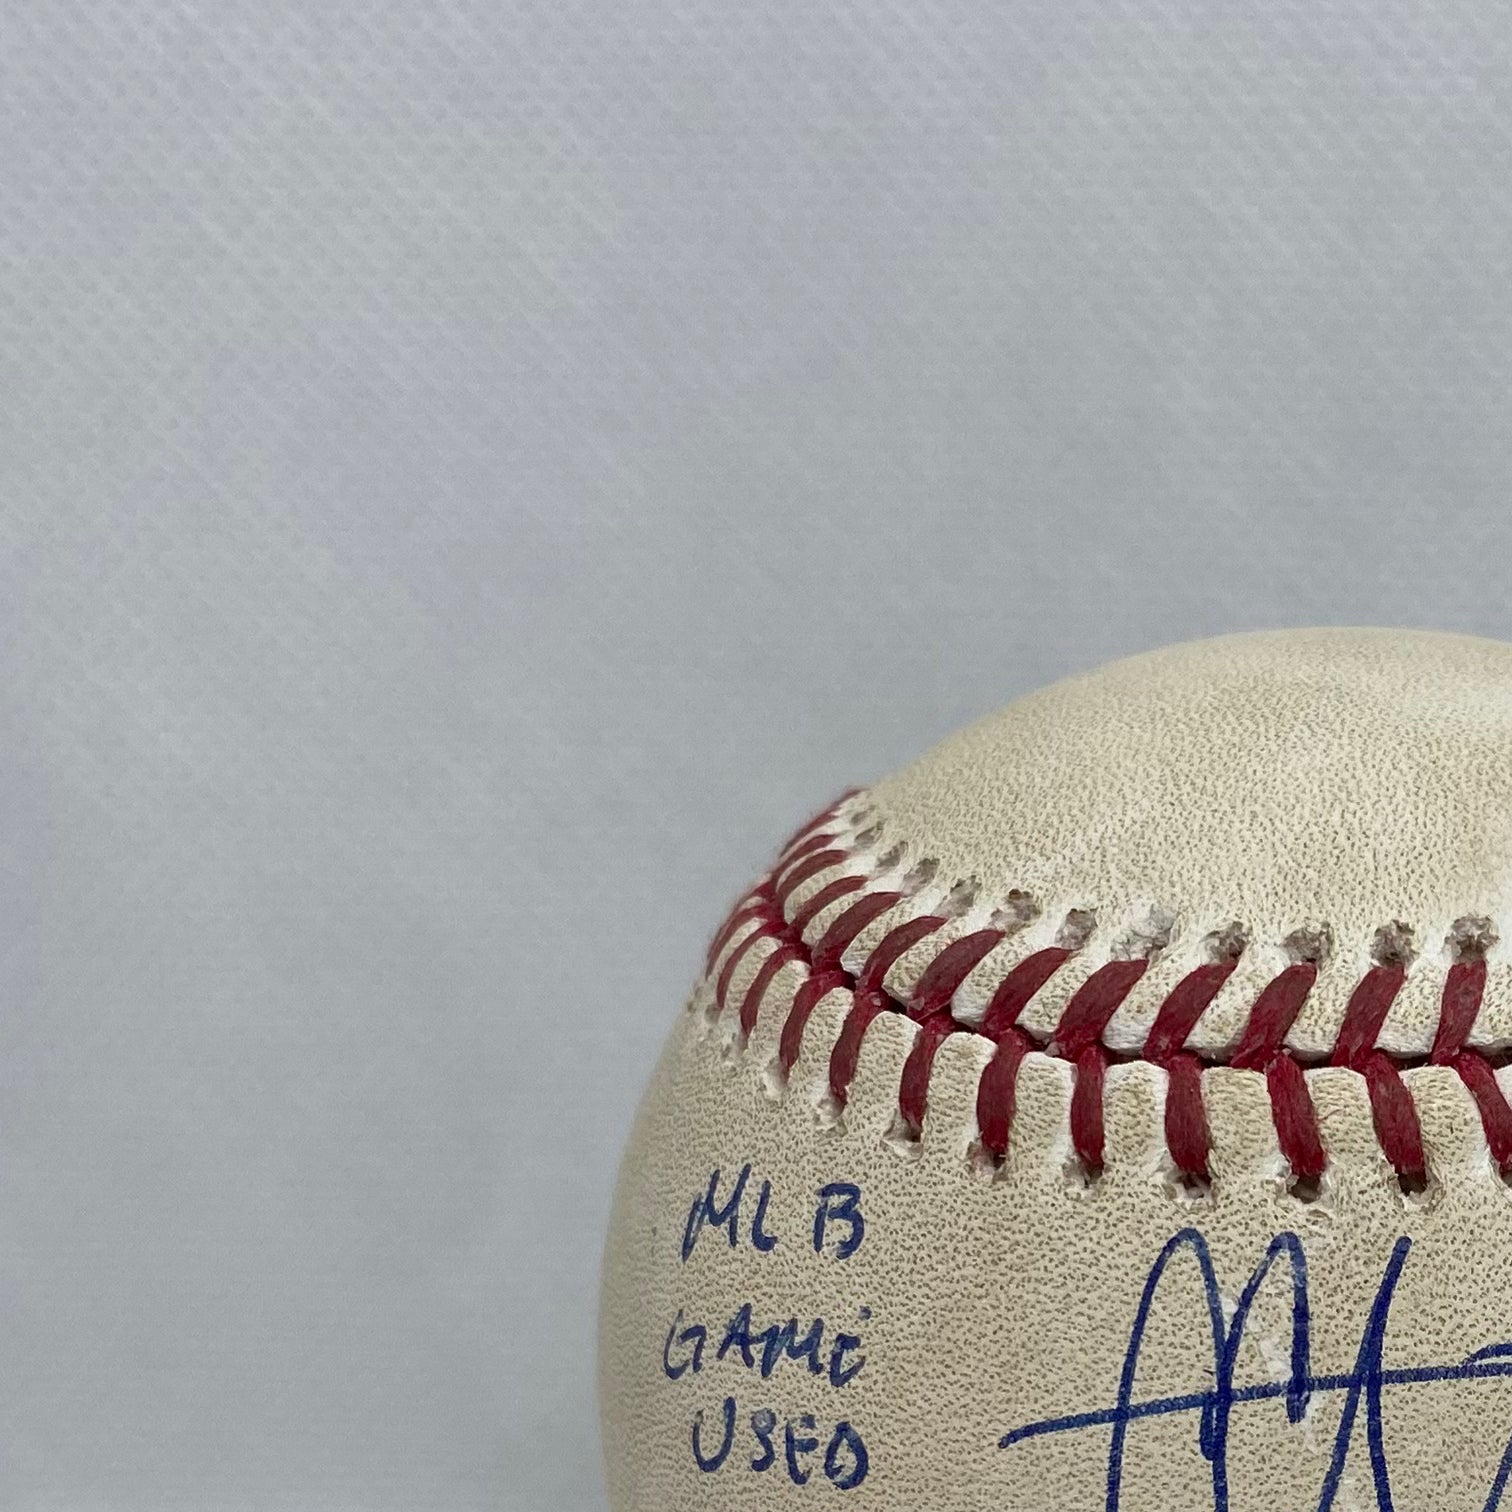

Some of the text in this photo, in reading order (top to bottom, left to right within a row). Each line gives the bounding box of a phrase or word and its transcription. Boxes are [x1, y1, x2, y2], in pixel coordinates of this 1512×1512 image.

[681, 1163, 866, 1265] MLB
[663, 1302, 872, 1388] GAME
[692, 1396, 869, 1490] USED
